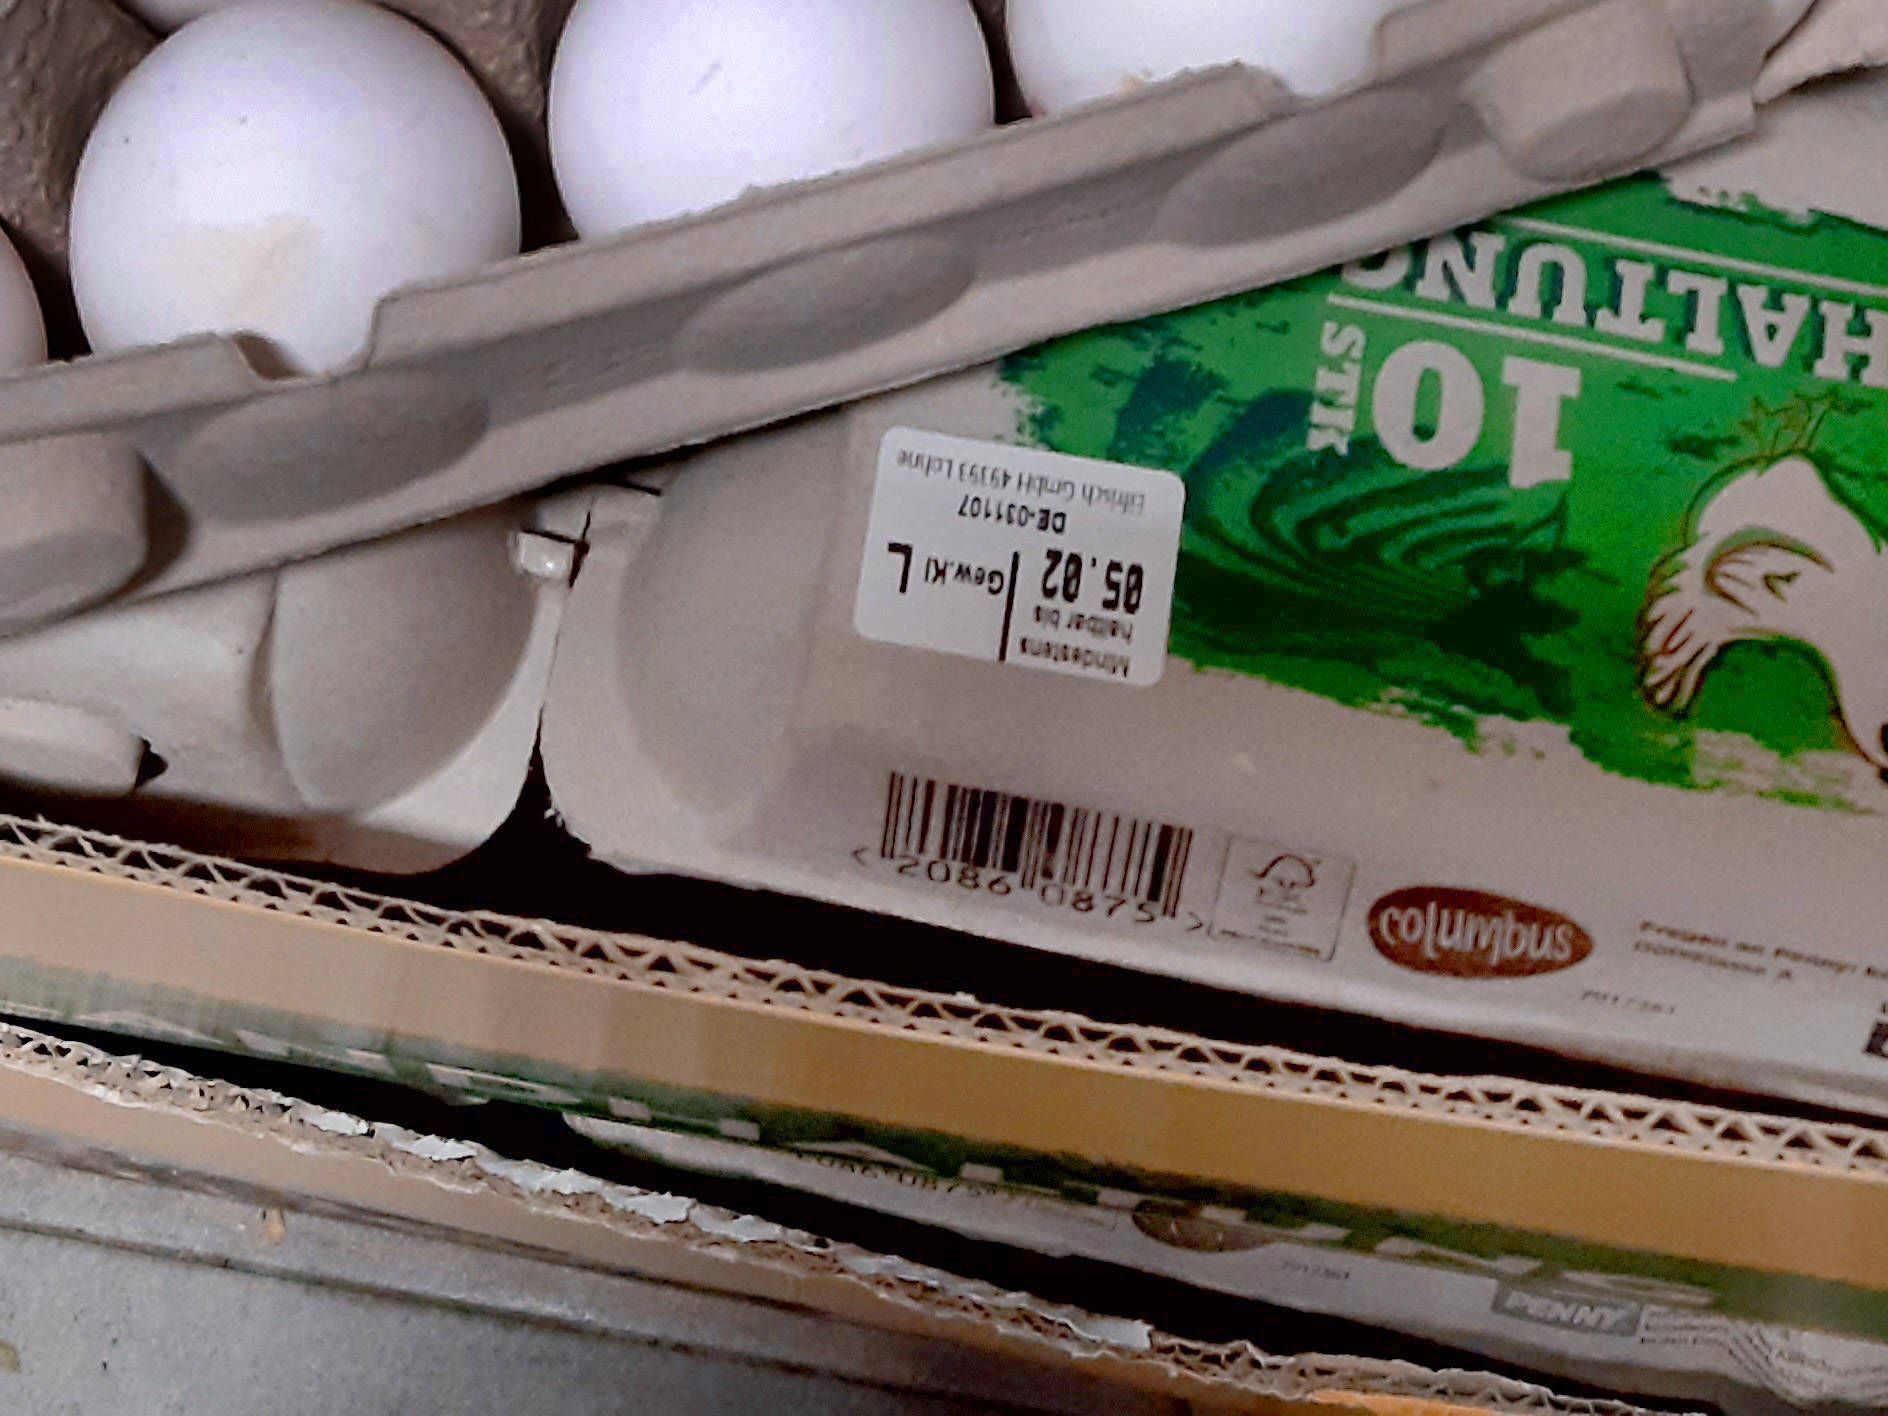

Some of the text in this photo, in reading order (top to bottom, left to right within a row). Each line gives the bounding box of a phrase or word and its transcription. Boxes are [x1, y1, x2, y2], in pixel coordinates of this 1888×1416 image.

[1306, 319, 1584, 491] 10 STK
[1017, 471, 1076, 500] GmbH
[957, 493, 1067, 535] DE-031107
[887, 541, 1006, 596] Gew.Kl L
[1041, 548, 1145, 615] 05.02
[1033, 604, 1134, 647] haltbar bis
[1019, 637, 1132, 680] Mindestens
[896, 852, 1159, 924] 2086 0875
[1376, 900, 1576, 964] columbus
[1509, 1289, 1634, 1330] PENNY
